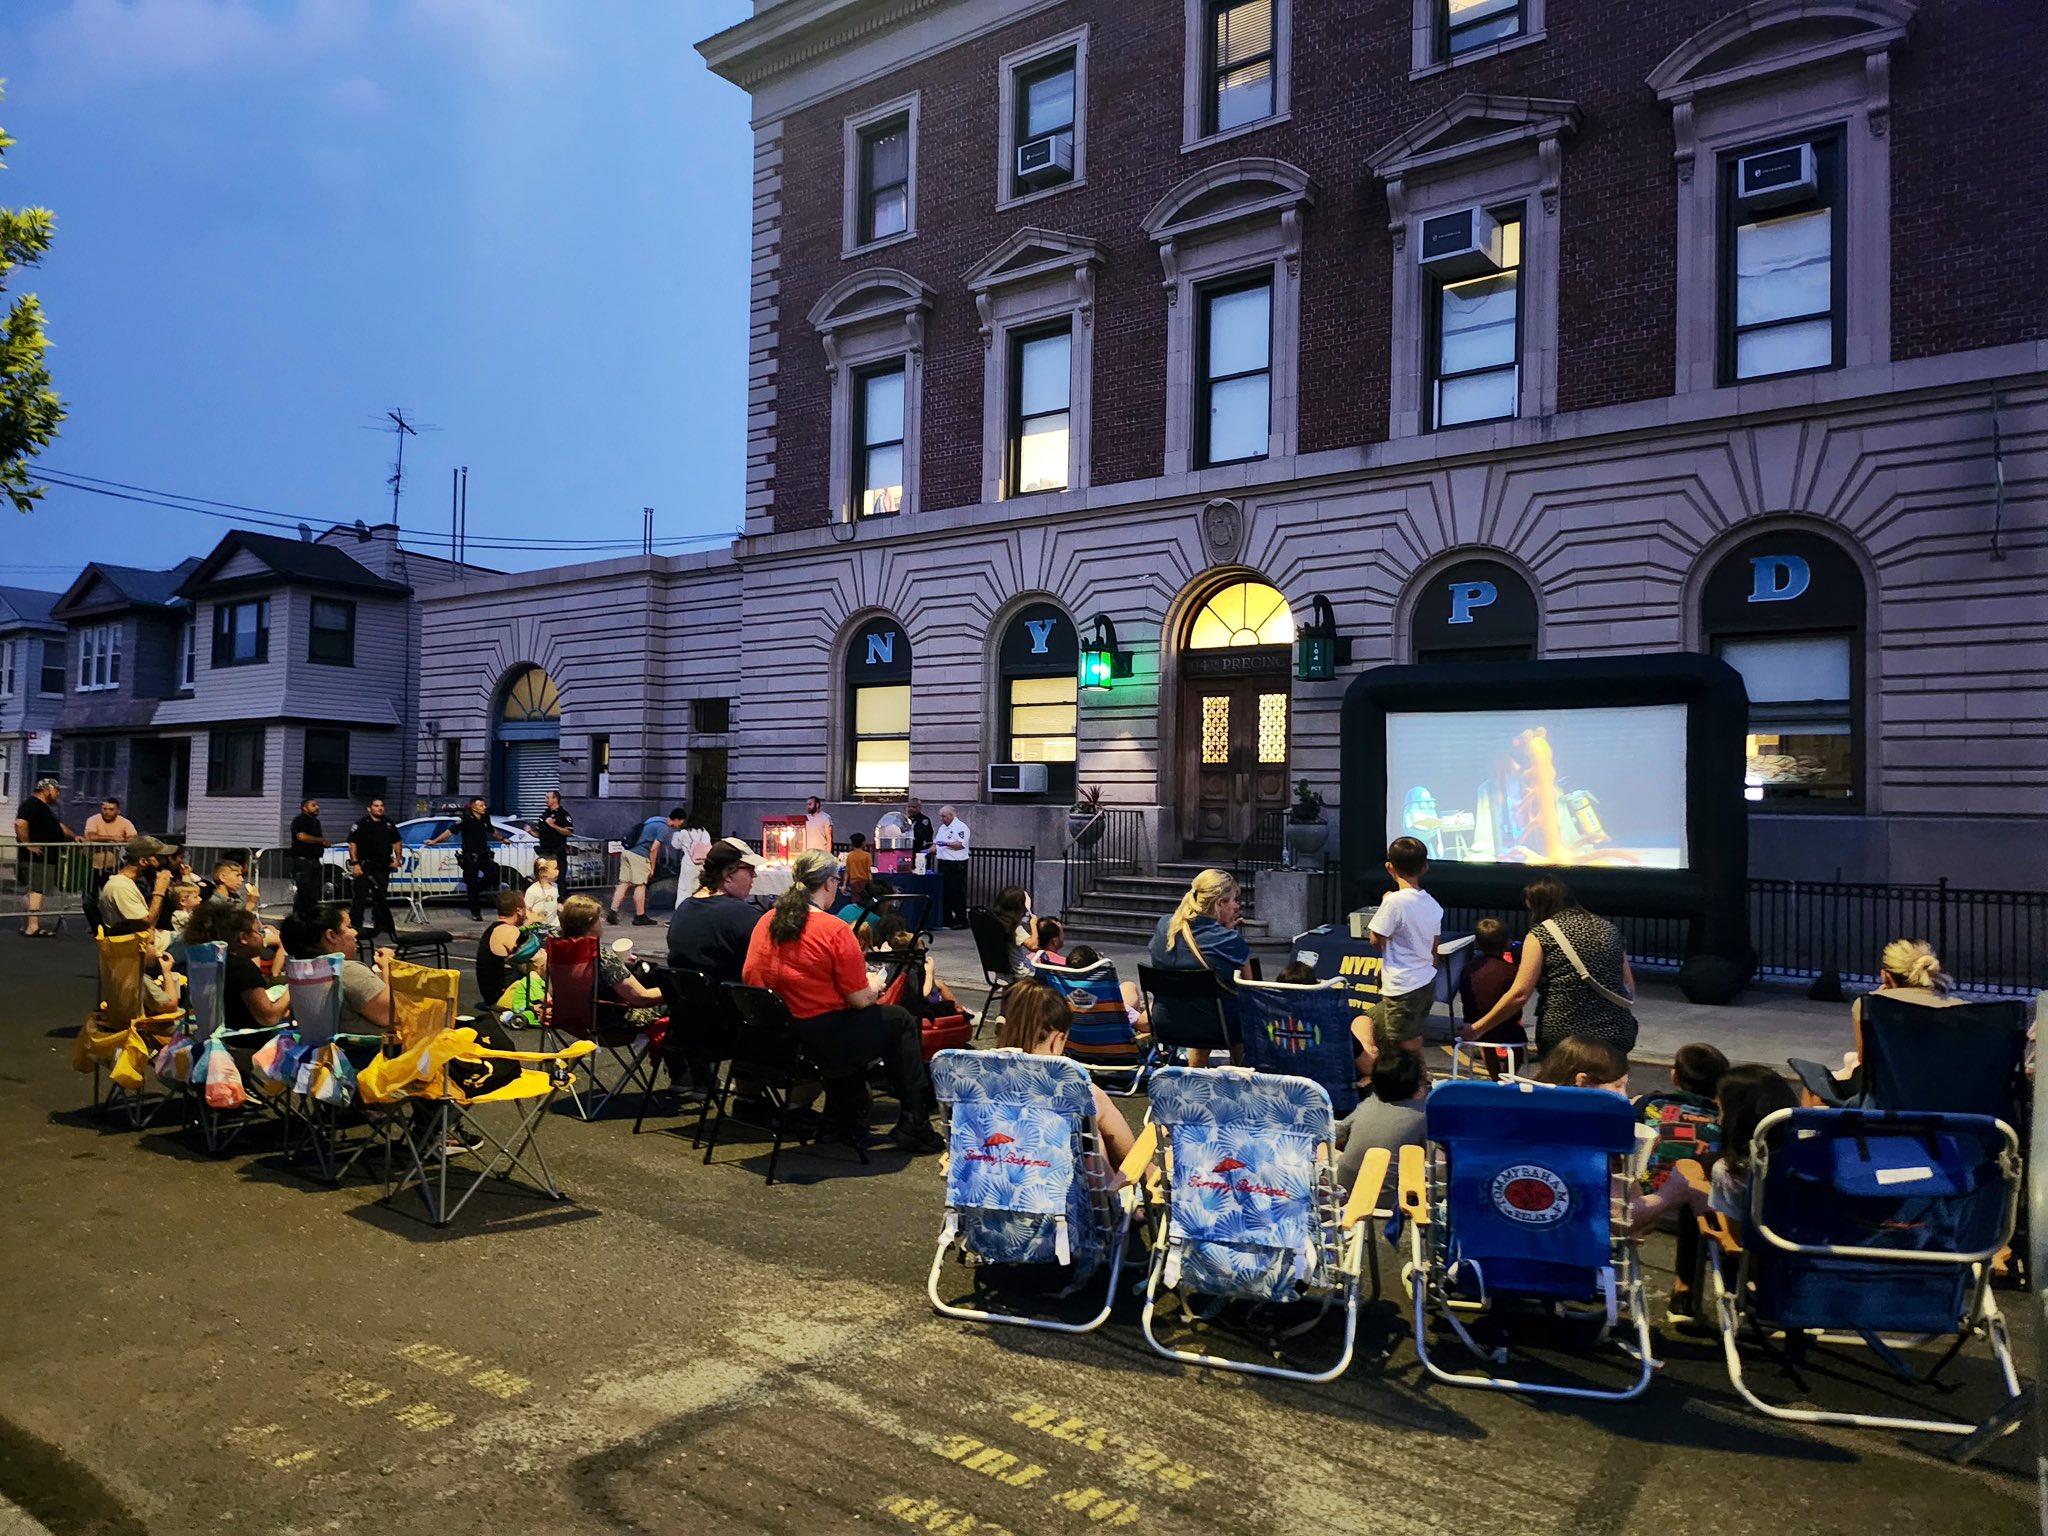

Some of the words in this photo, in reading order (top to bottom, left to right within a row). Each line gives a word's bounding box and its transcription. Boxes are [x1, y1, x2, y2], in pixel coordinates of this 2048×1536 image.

[866, 632, 895, 664] N
[1024, 619, 1057, 654] Y
[1447, 580, 1498, 624] P
[1747, 555, 1811, 603] D
[1222, 656, 1286, 671] PRECINC
